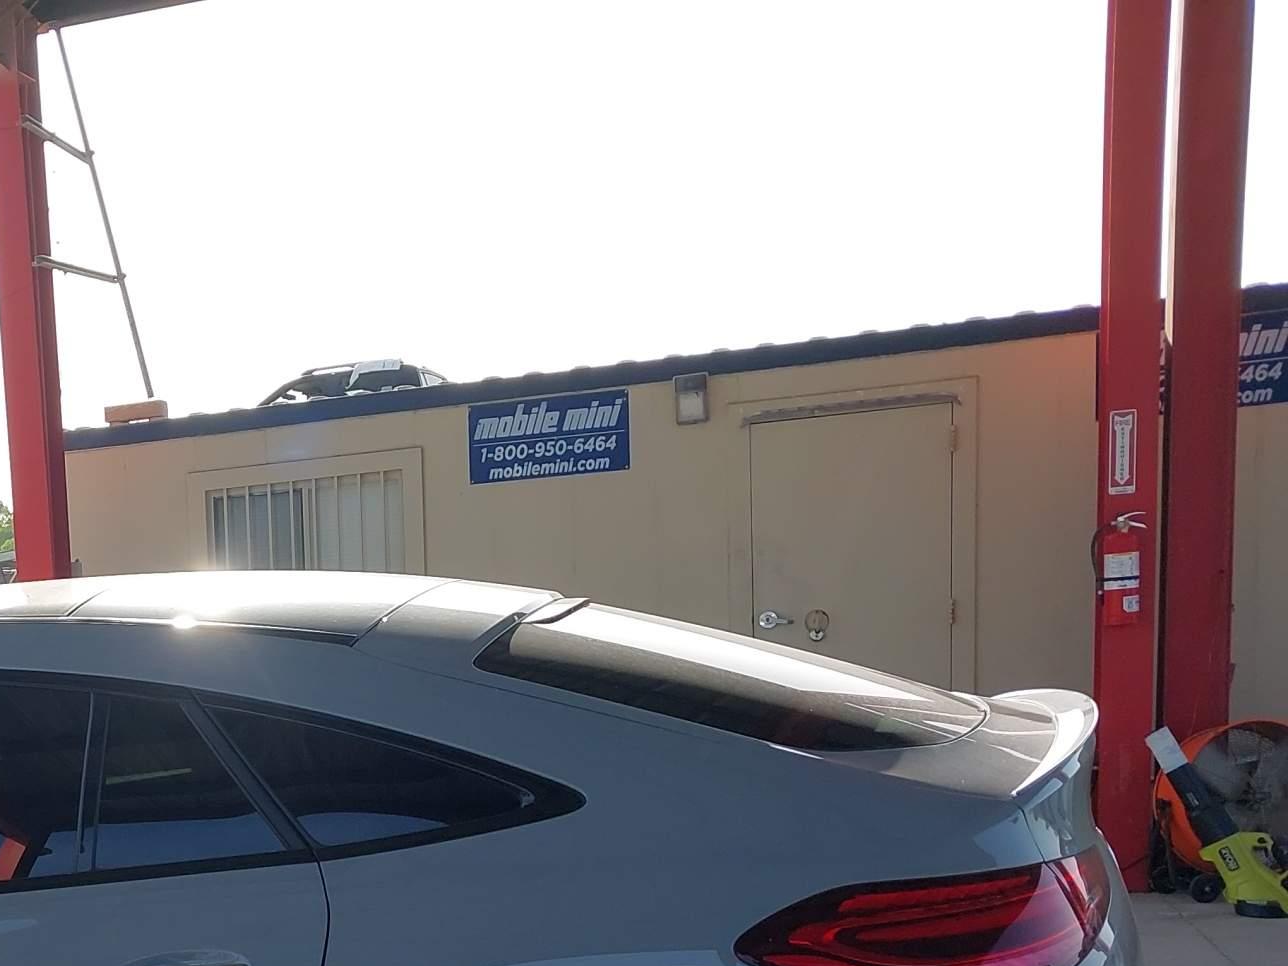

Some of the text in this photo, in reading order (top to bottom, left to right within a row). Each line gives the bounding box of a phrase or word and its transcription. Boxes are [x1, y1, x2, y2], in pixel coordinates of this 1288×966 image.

[474, 399, 622, 440] mobile mini
[481, 435, 617, 463] 1-800-950-6464
[489, 458, 610, 480] mobilemini.com
